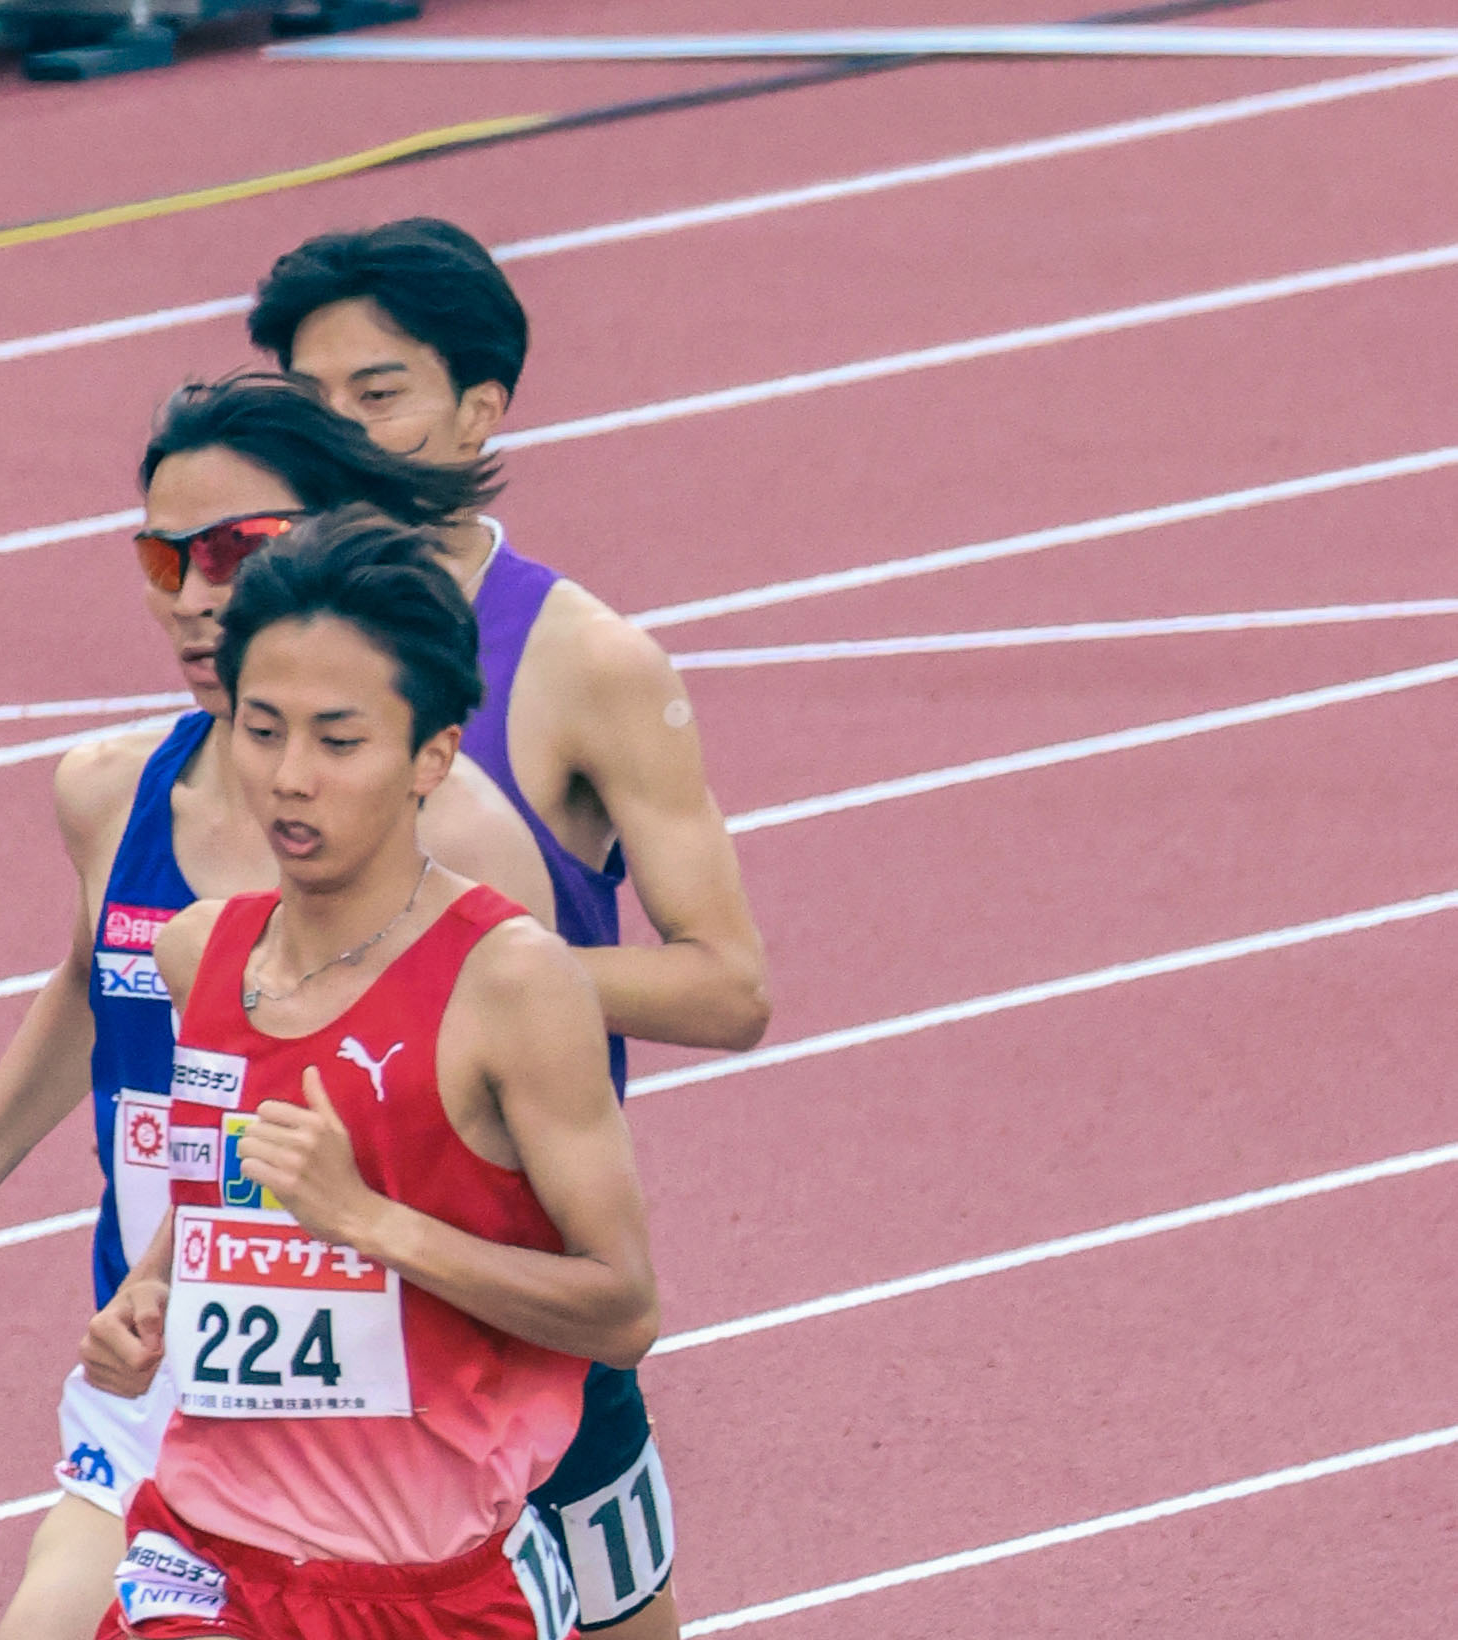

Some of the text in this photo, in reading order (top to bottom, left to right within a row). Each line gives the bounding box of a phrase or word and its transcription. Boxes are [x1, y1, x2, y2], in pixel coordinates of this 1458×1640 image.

[216, 1232, 374, 1280] ヤマザキ
[193, 1301, 342, 1387] 224
[588, 1466, 666, 1602] 11
[139, 1587, 220, 1606] NITTA
